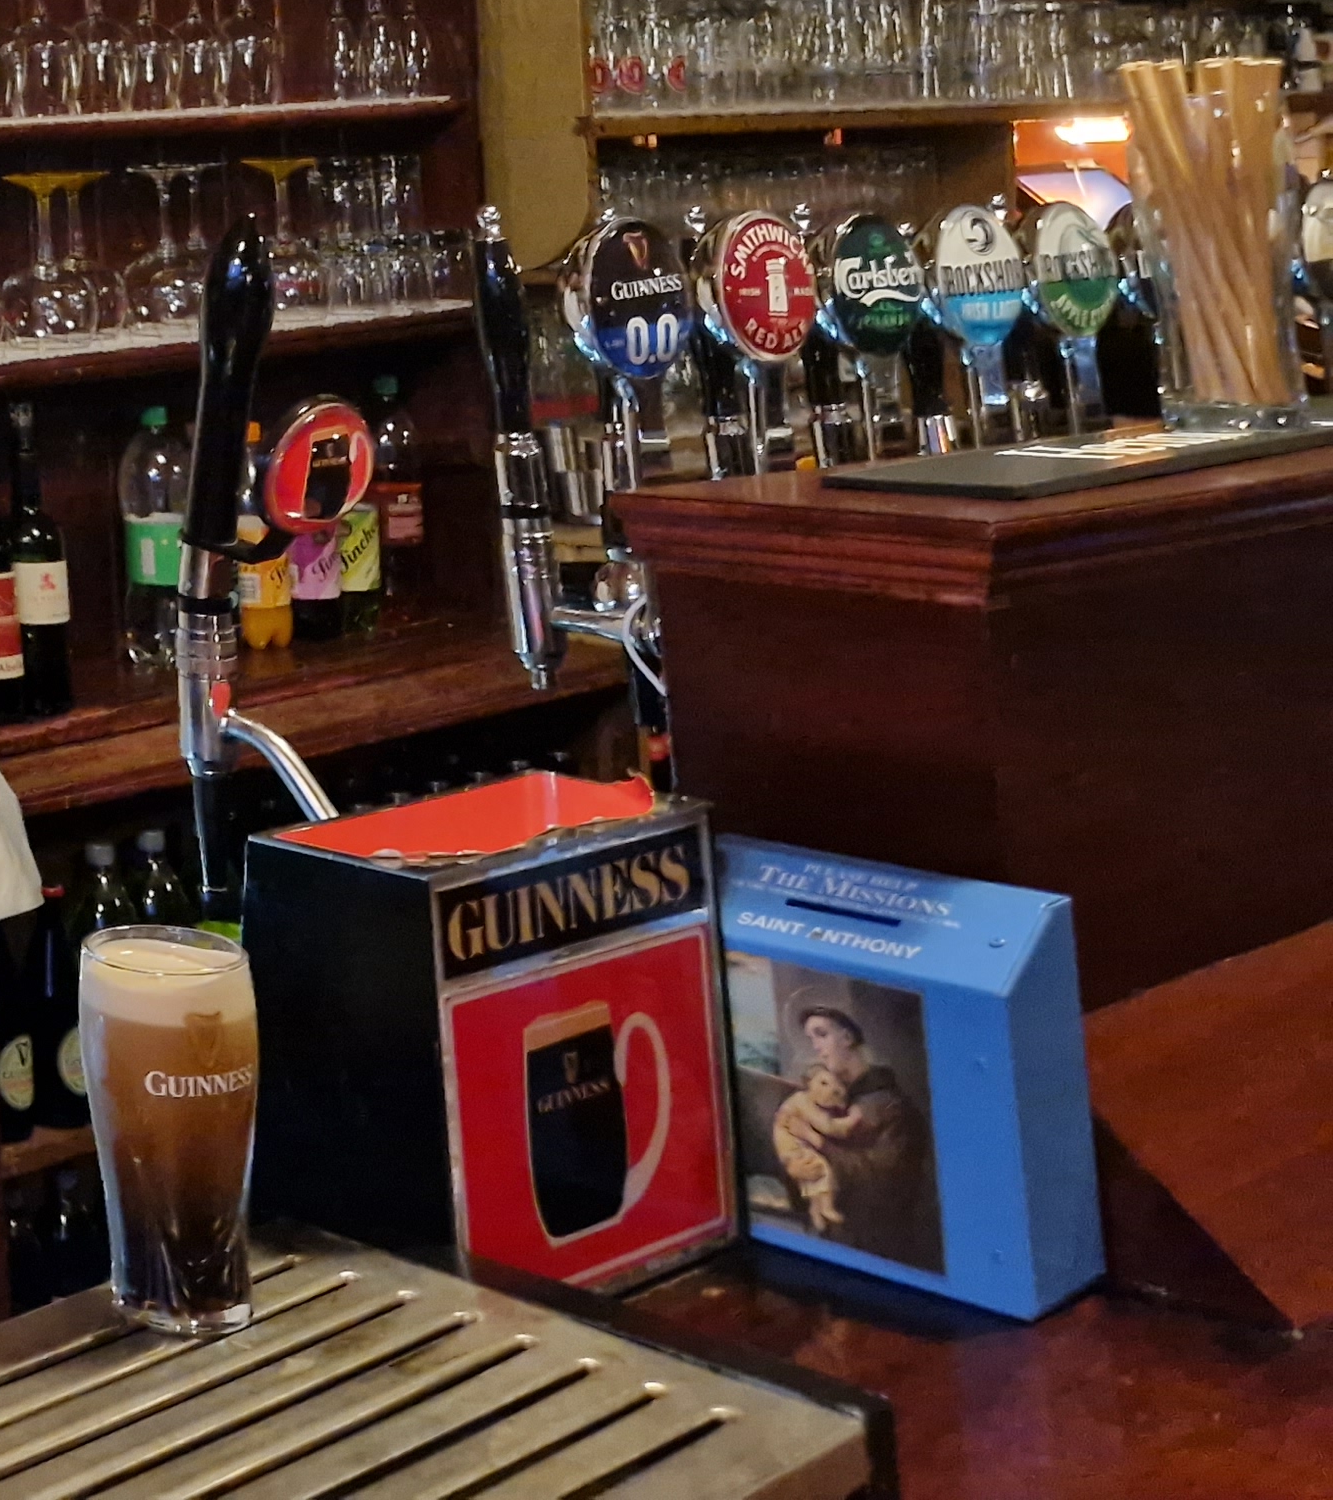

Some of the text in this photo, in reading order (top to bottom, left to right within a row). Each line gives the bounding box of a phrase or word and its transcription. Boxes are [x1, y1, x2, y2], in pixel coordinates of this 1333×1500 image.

[610, 273, 684, 301] GUINNESS
[625, 312, 680, 366] 0.0
[744, 316, 808, 350] RED ALE
[446, 844, 691, 963] GUINNESS
[759, 863, 810, 891] THE
[819, 875, 953, 917] MISSIONS
[736, 910, 923, 961] SAINT ANTHONY
[144, 1067, 253, 1099] GUINNESS
[537, 1080, 613, 1116] GUINNESS
